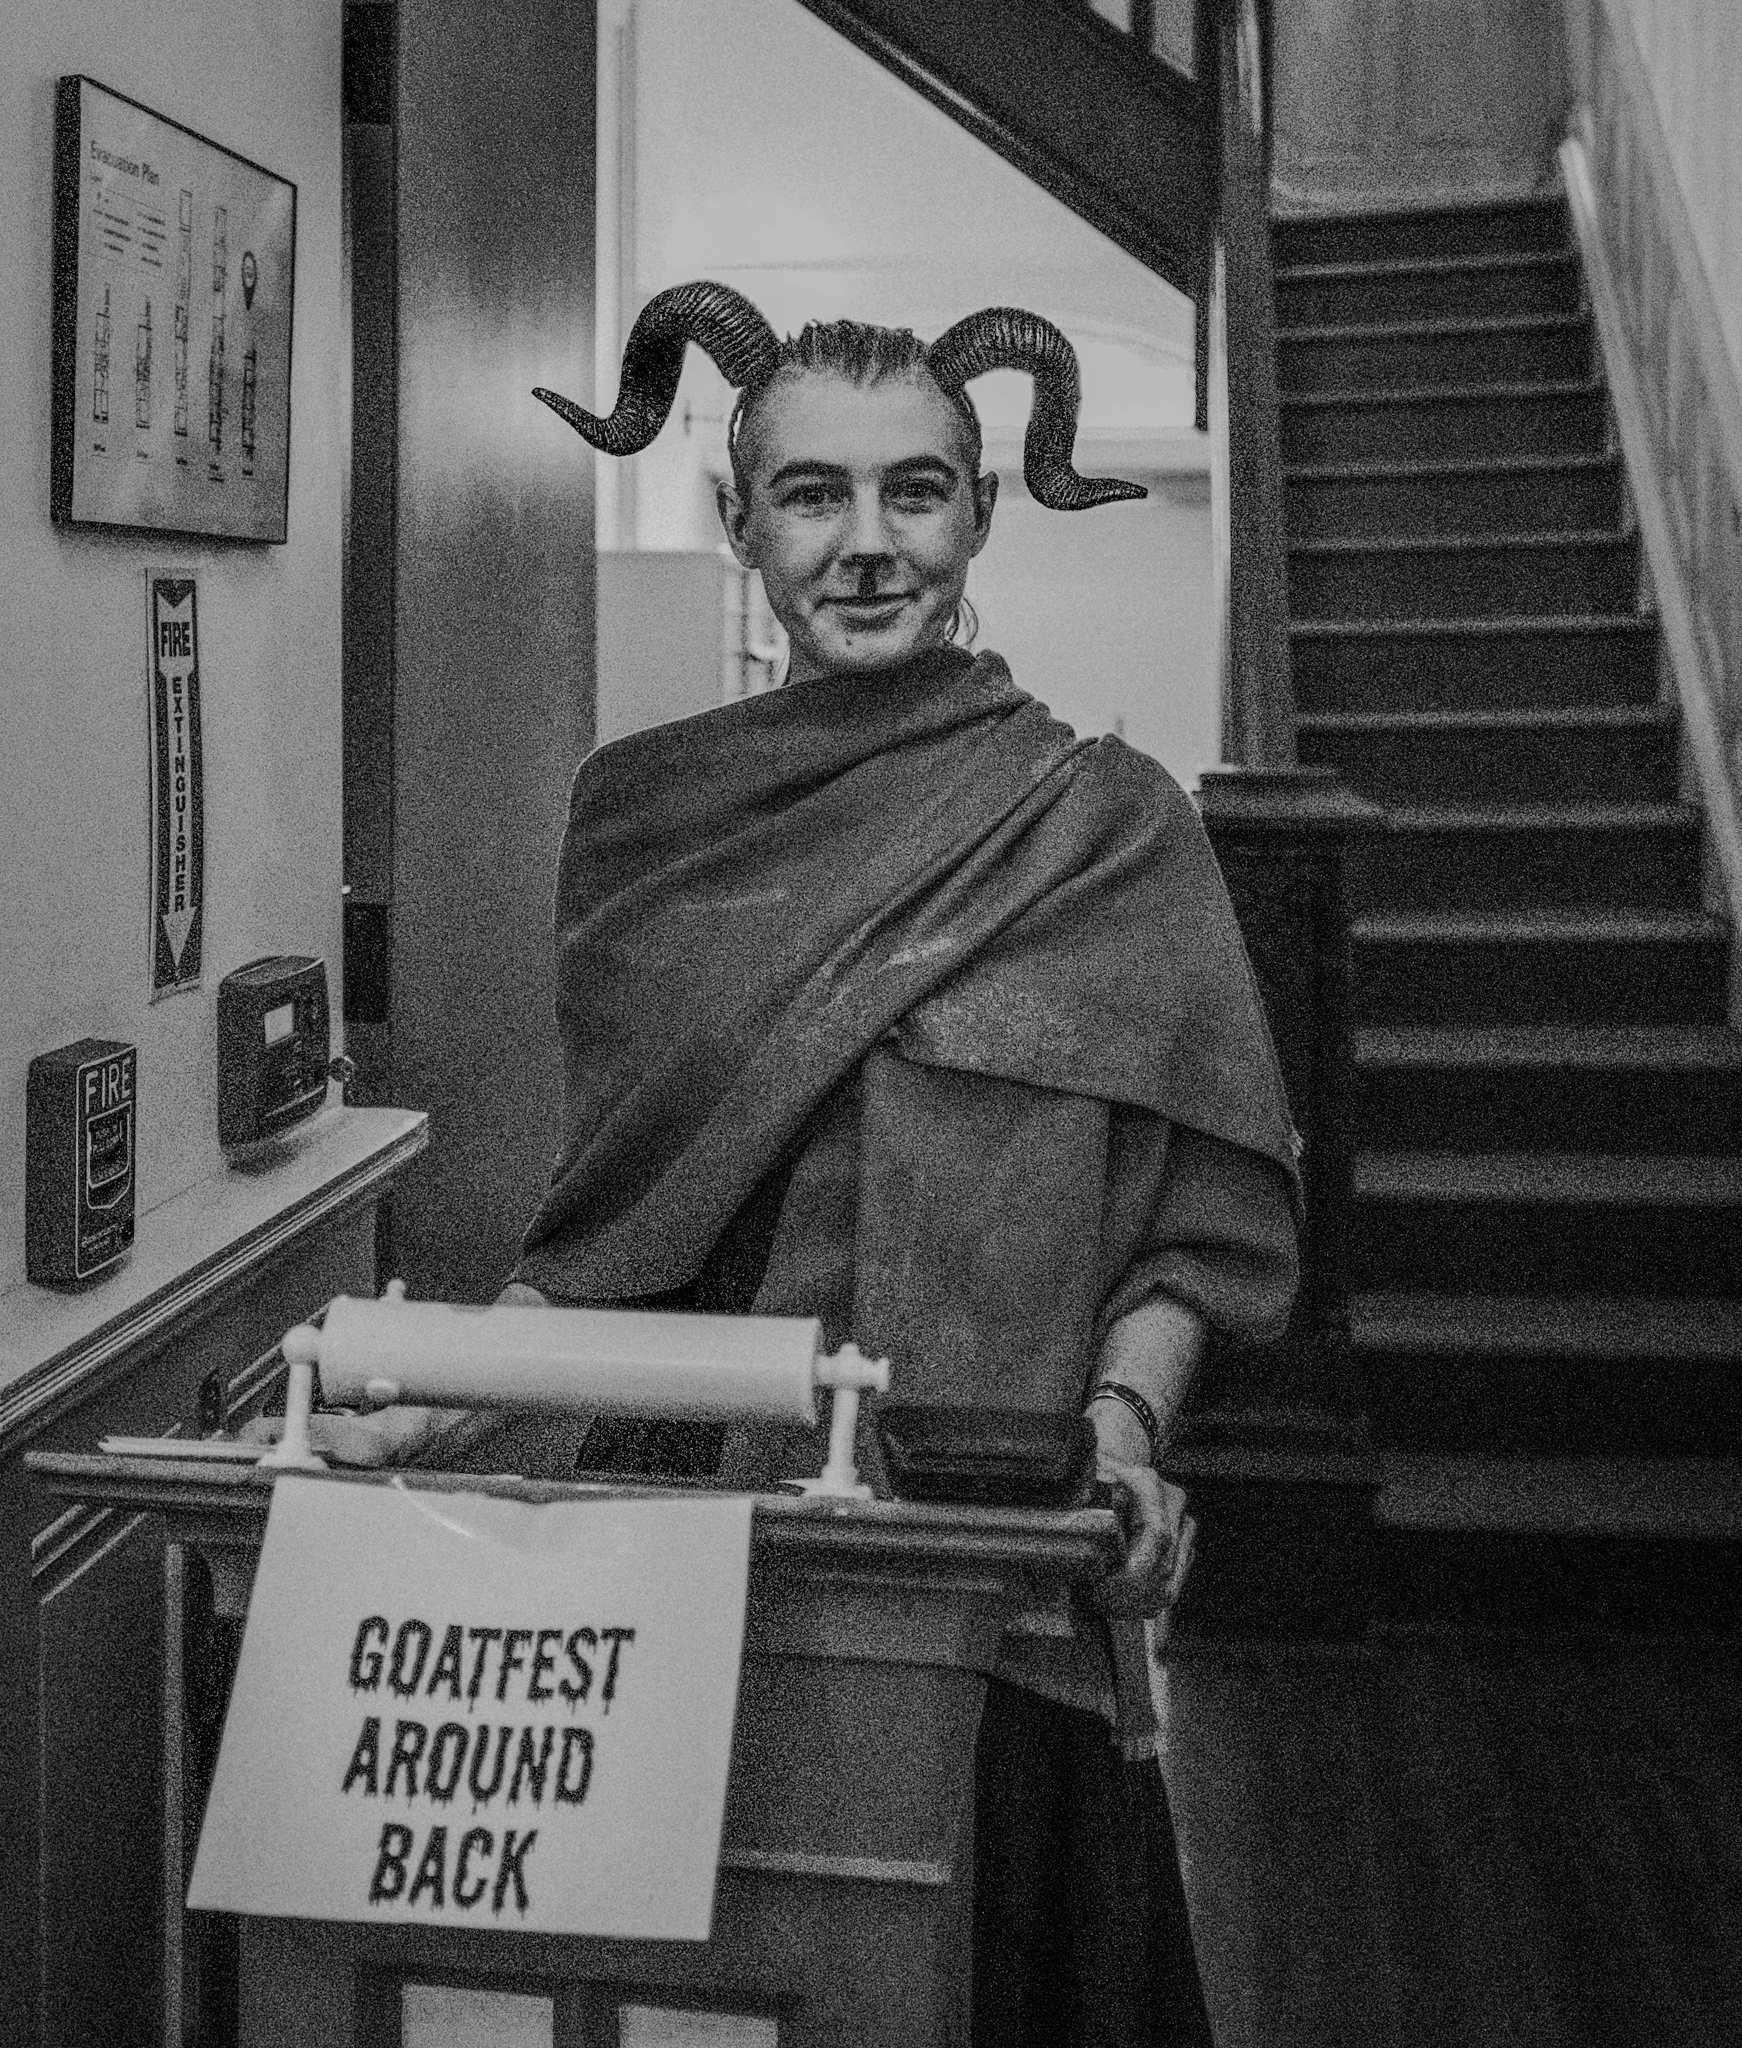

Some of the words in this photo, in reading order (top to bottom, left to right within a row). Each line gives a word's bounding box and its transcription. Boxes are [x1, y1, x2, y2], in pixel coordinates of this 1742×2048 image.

[160, 621, 191, 657] FIRE
[172, 676, 186, 913] EXTINGUISHER
[85, 1057, 132, 1114] FIRE
[348, 1615, 636, 1714] GOATFEST
[342, 1716, 596, 1813] AROUND
[368, 1822, 539, 1917] BACK
